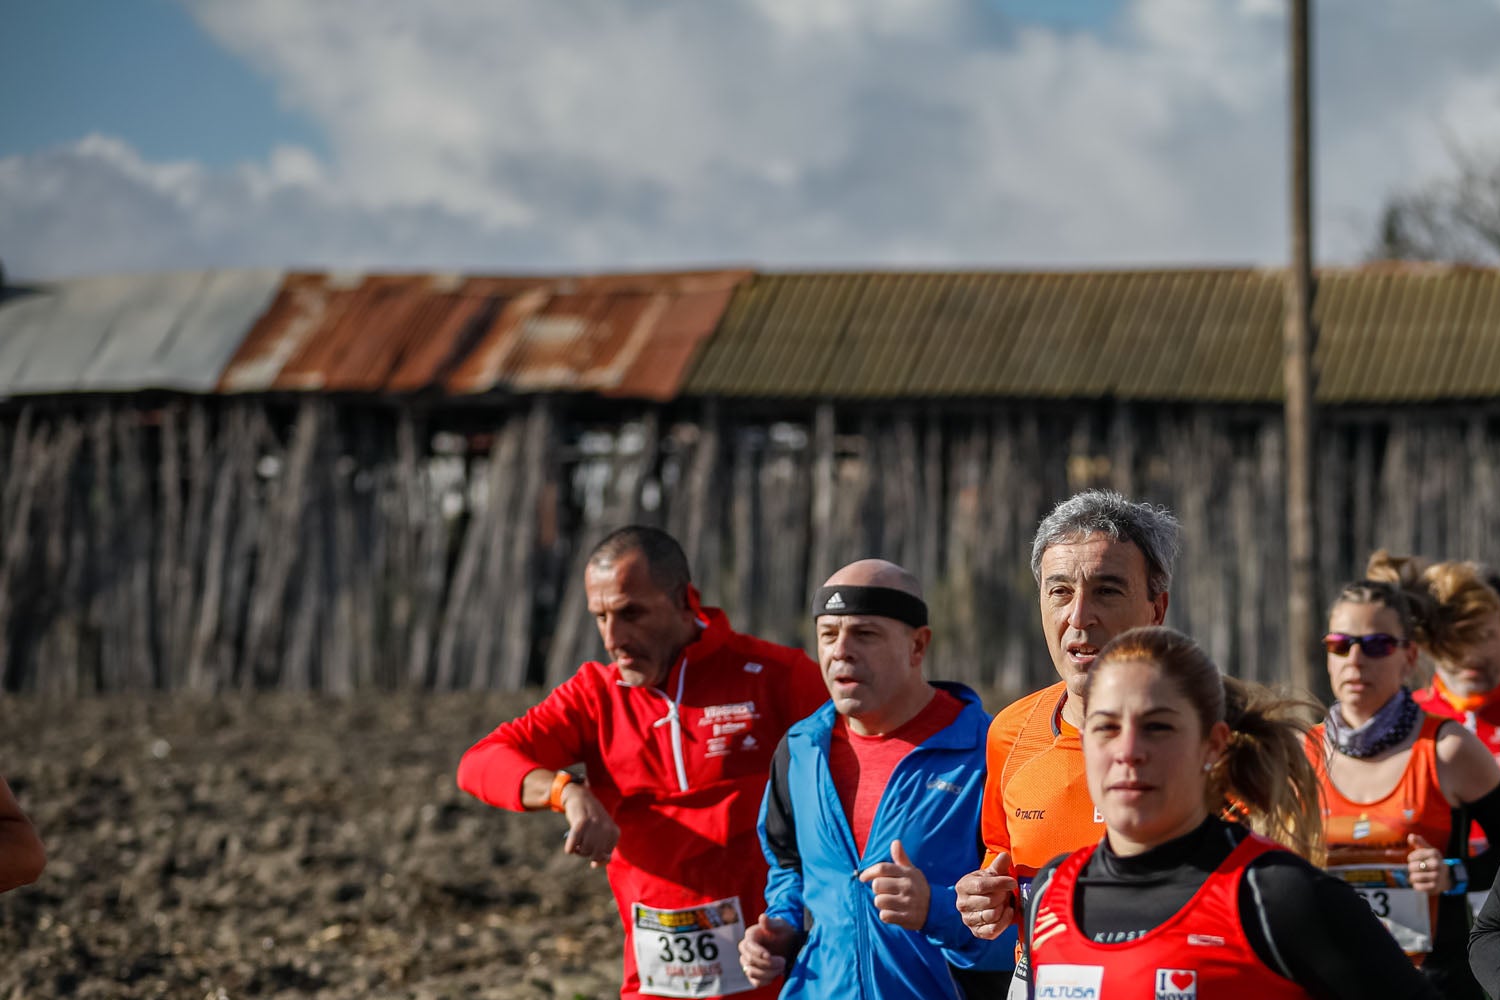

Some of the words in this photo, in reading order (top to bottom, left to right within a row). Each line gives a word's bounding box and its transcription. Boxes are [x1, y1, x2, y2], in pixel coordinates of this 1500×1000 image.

[1021, 810, 1046, 819] TACTIC
[1359, 891, 1391, 918] 3
[658, 933, 719, 963] 336
